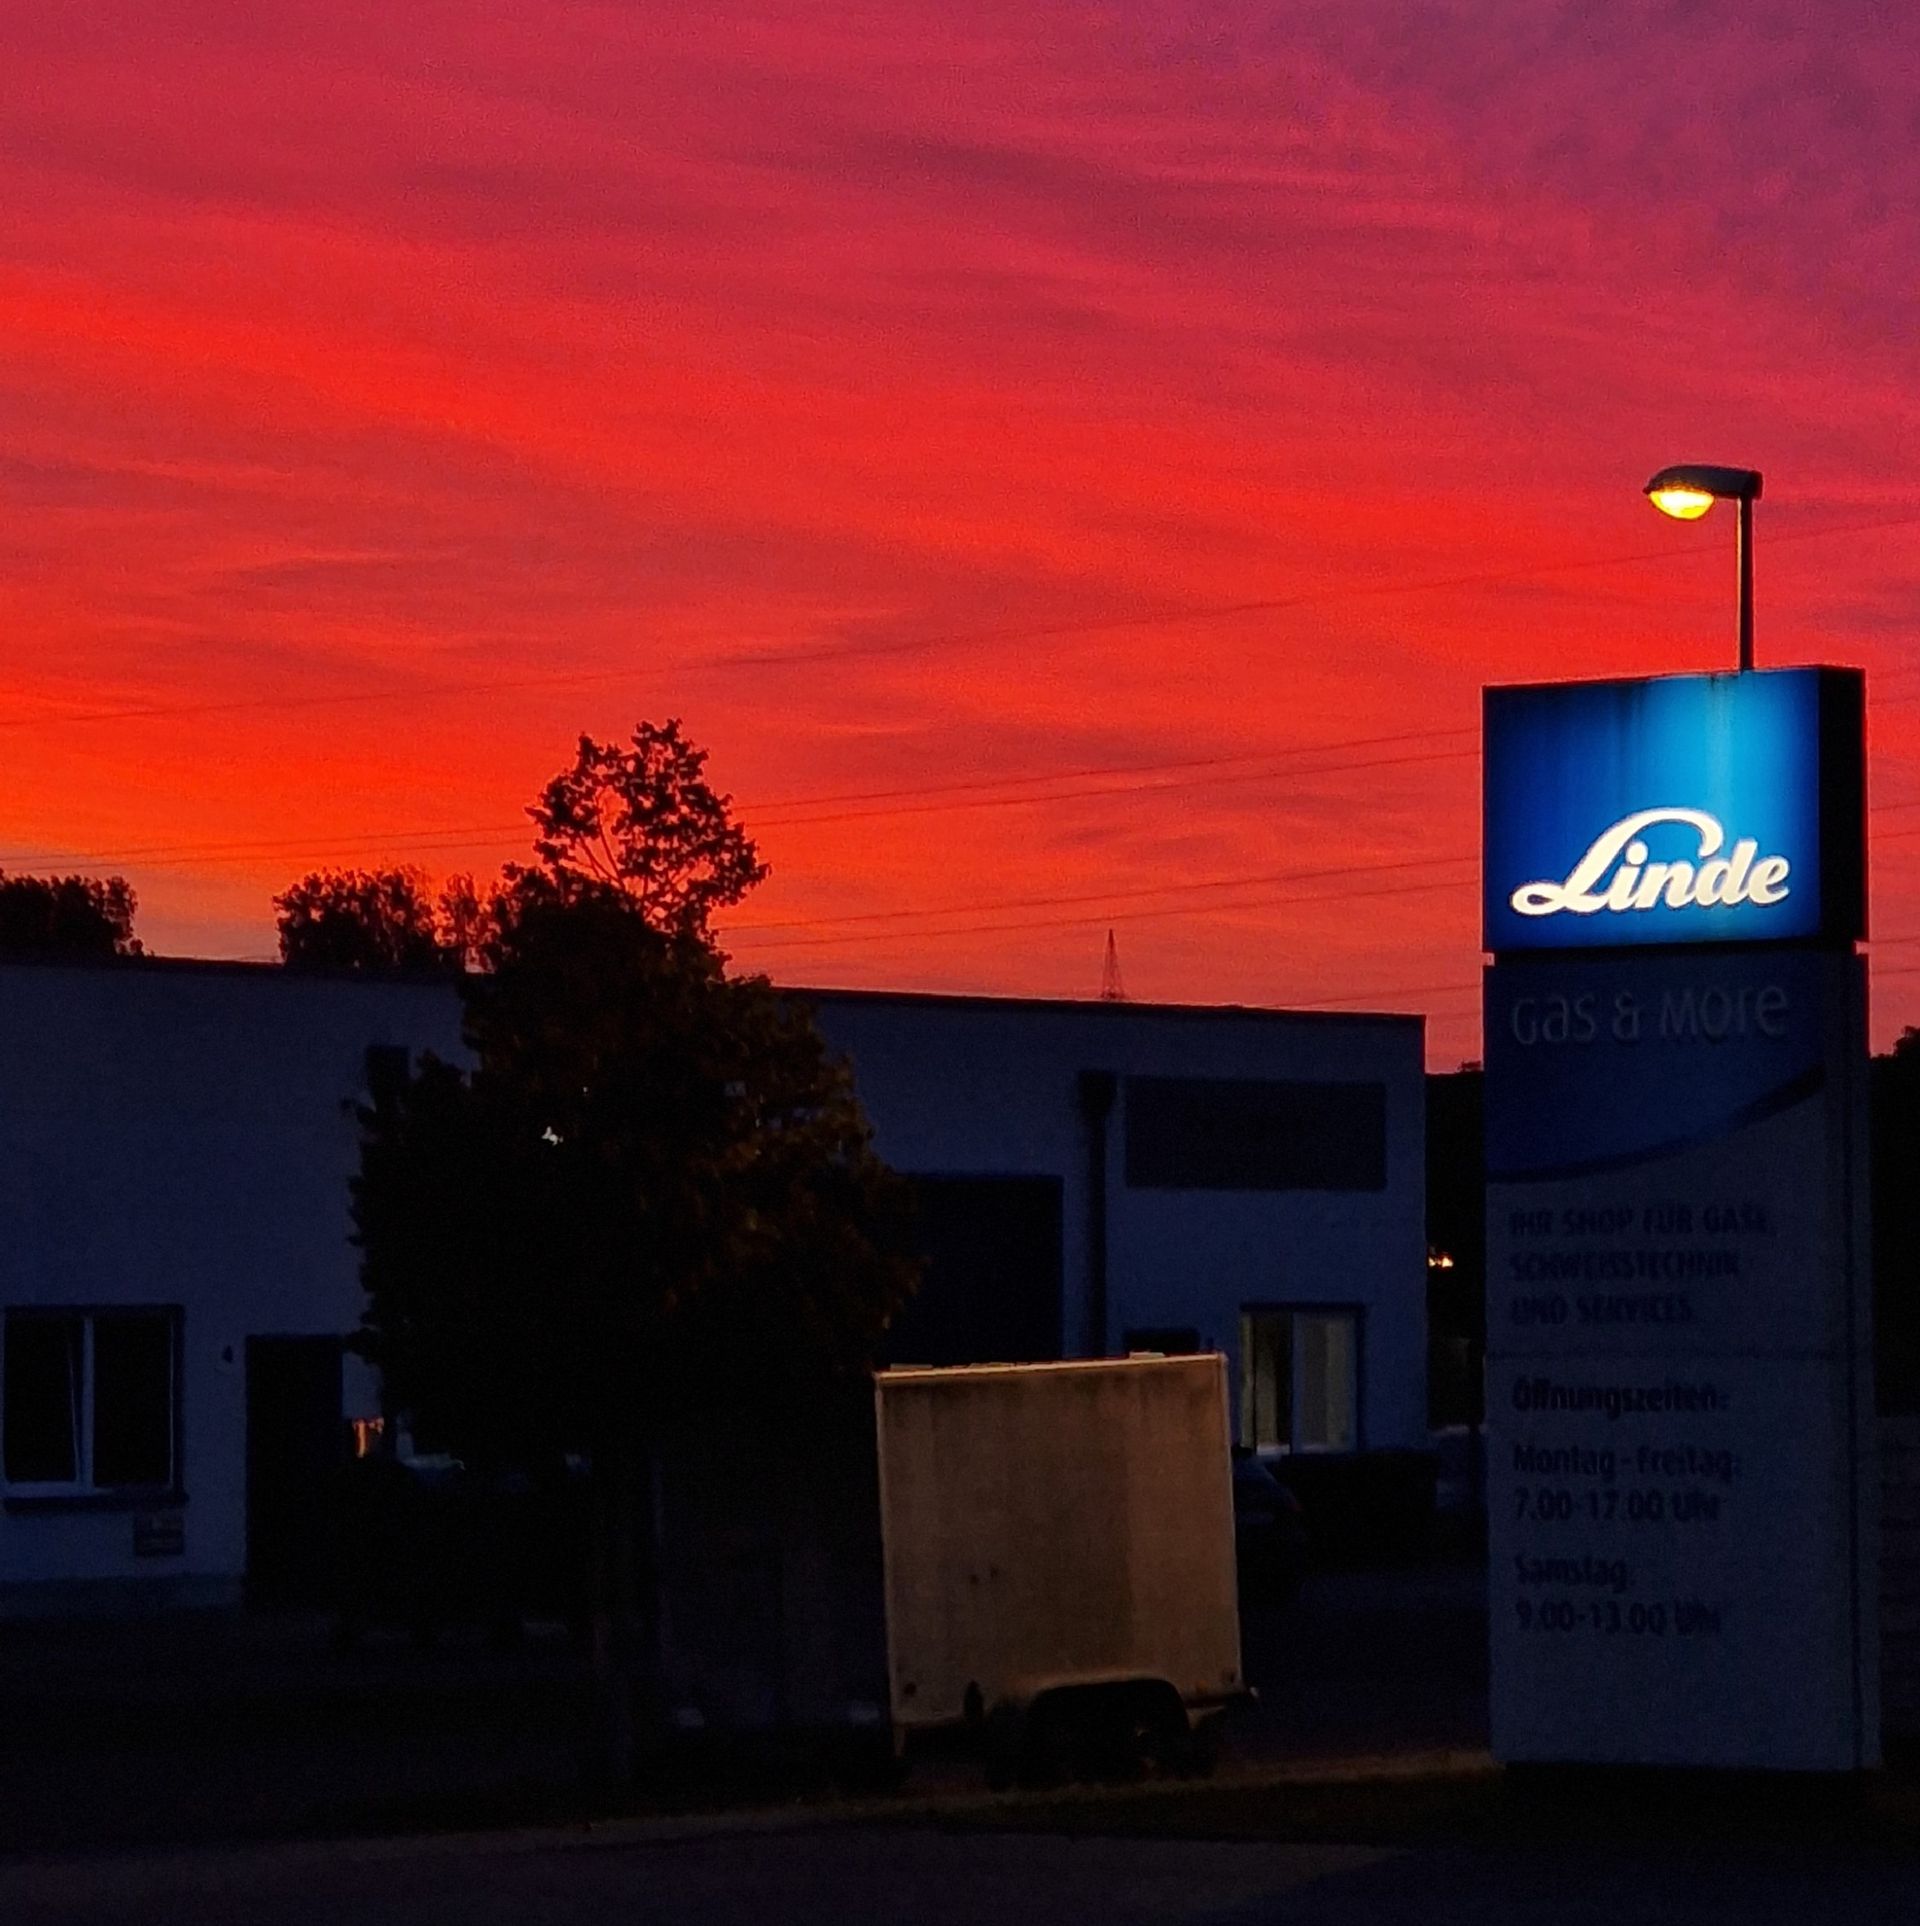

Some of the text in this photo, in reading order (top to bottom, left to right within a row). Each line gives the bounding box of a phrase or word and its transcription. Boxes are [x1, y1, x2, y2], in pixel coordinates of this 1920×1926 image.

[1509, 807, 1790, 916] Linde
[1611, 990, 1644, 1042] &
[1510, 1209, 1552, 1235] IHR
[1562, 1206, 1634, 1235] SHOP
[1510, 1297, 1568, 1325] UND
[1672, 1489, 1720, 1521] Uhr
